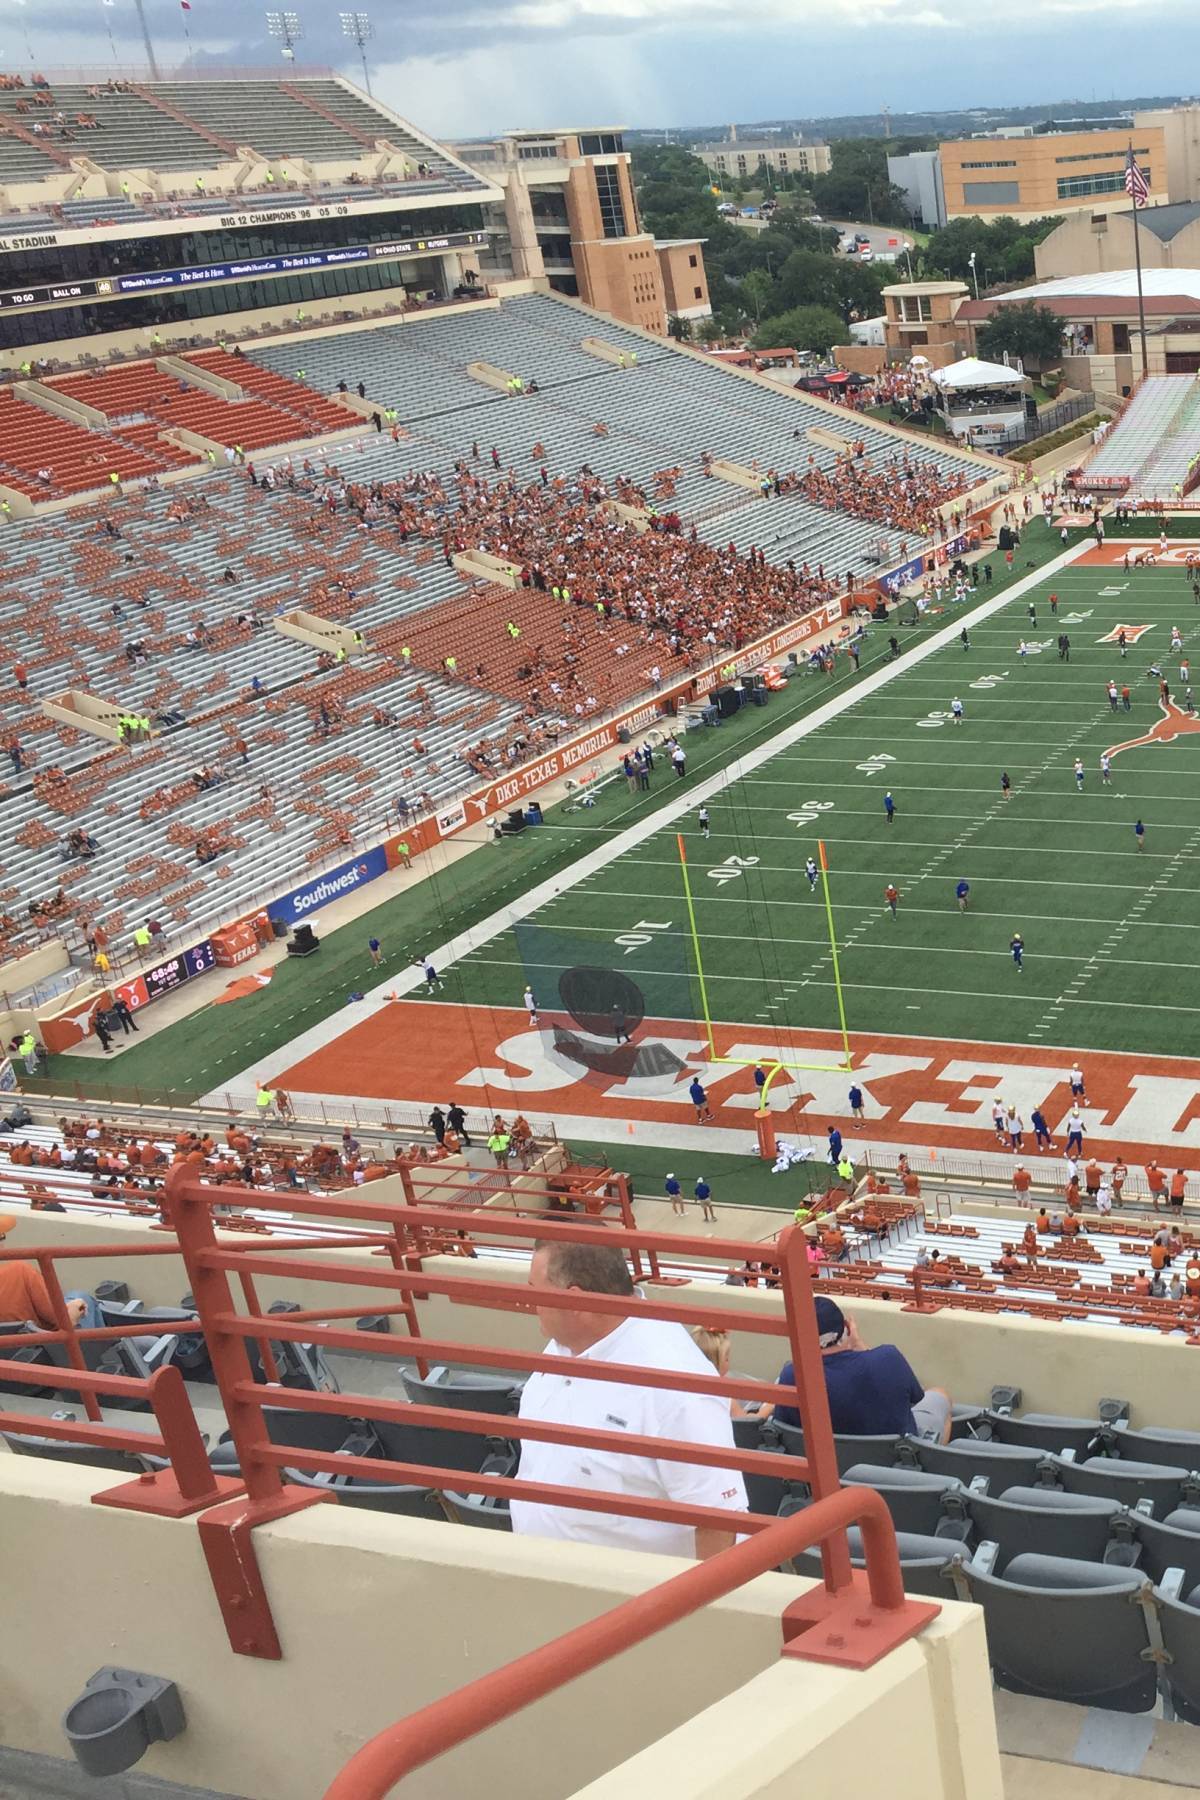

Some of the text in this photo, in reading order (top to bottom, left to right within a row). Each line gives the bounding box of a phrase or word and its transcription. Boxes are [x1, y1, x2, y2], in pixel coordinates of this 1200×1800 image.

[221, 216, 236, 227] BIG
[237, 216, 248, 226] 12
[249, 211, 297, 225] CHAMPIONS
[299, 209, 311, 219] '96
[12, 235, 57, 249] STADIUM
[396, 244, 412, 252] STATE
[11, 295, 22, 303] TO
[23, 293, 34, 302] GO
[52, 287, 81, 298] BALL ON
[1075, 477, 1109, 485] SMOKEY
[773, 619, 812, 652] LONGHORNS
[496, 761, 560, 804] DKR-TEXAS
[561, 729, 615, 765] MEMORIAL
[855, 753, 897, 771] 40
[786, 800, 835, 822] 30
[706, 855, 761, 879] 20
[293, 865, 361, 914] Southwest
[613, 919, 673, 947] 10
[231, 942, 258, 964] TEXAS
[195, 958, 205, 971] 0
[130, 994, 140, 1007] 0
